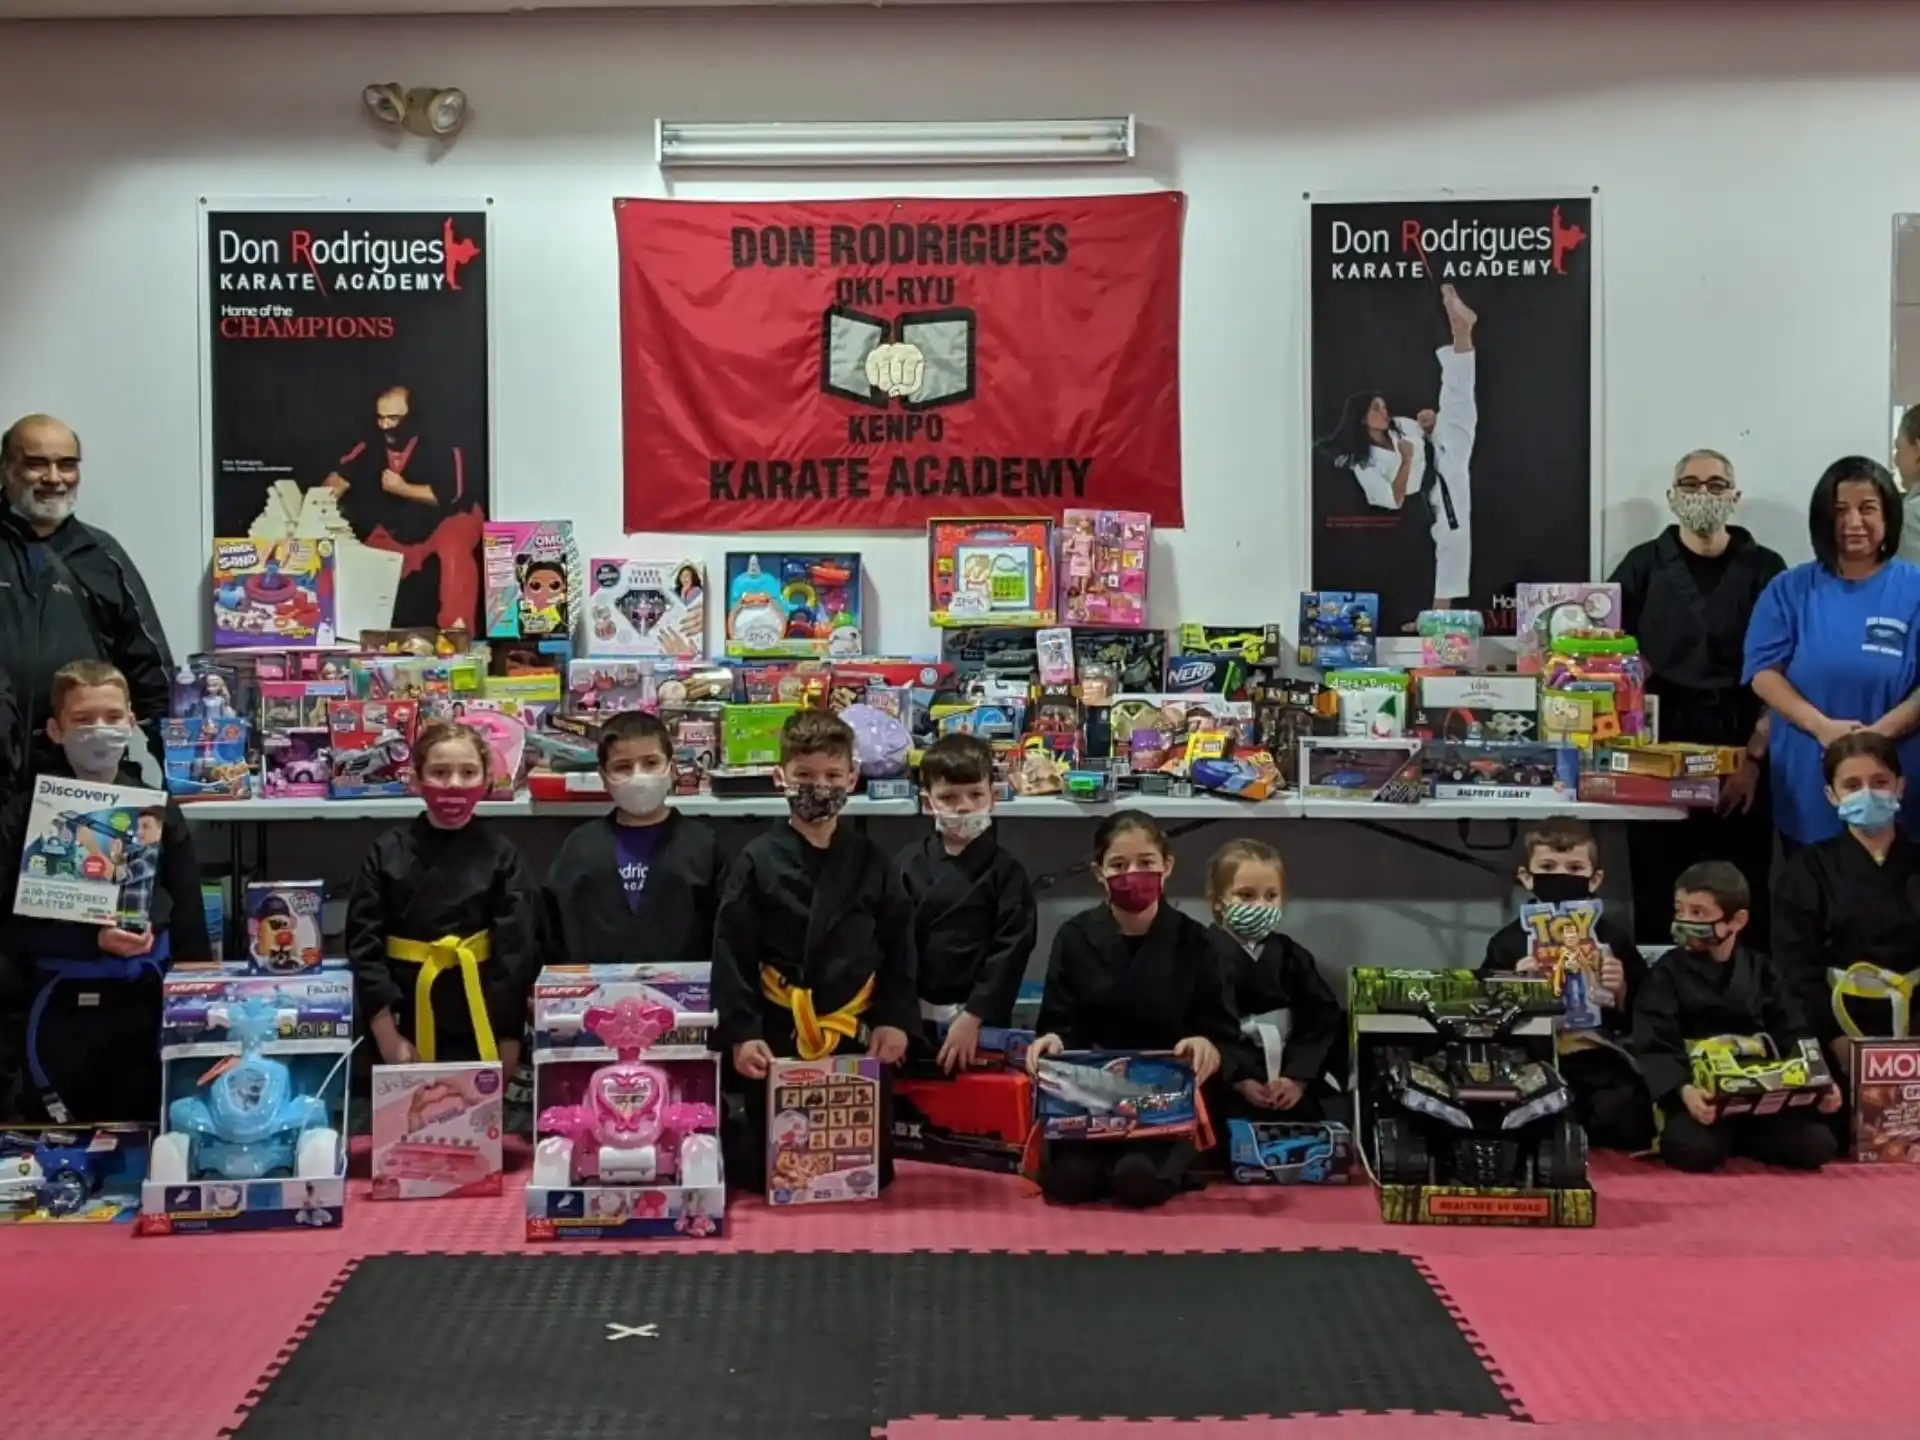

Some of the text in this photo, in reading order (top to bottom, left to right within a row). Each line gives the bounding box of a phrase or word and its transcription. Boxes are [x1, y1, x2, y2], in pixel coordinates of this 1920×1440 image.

[219, 229, 444, 273] Don Rodrigues
[731, 223, 1069, 268] DON RODRIGUES
[1332, 219, 1552, 260] Don Rodrigues
[220, 273, 445, 290] KARATE ACADEMY
[1332, 259, 1552, 279] KARATE ACADEMY
[836, 277, 955, 306] OKI-RYU
[221, 304, 294, 317] Home of the
[219, 315, 394, 339] CHAMPIONS
[848, 414, 944, 444] KENPO
[709, 454, 1093, 502] KARATE ACADEMY
[1168, 663, 1214, 685] NERF
[39, 780, 120, 806] Discovery
[1528, 908, 1597, 944] TOY
[306, 984, 349, 996] FROZEN
